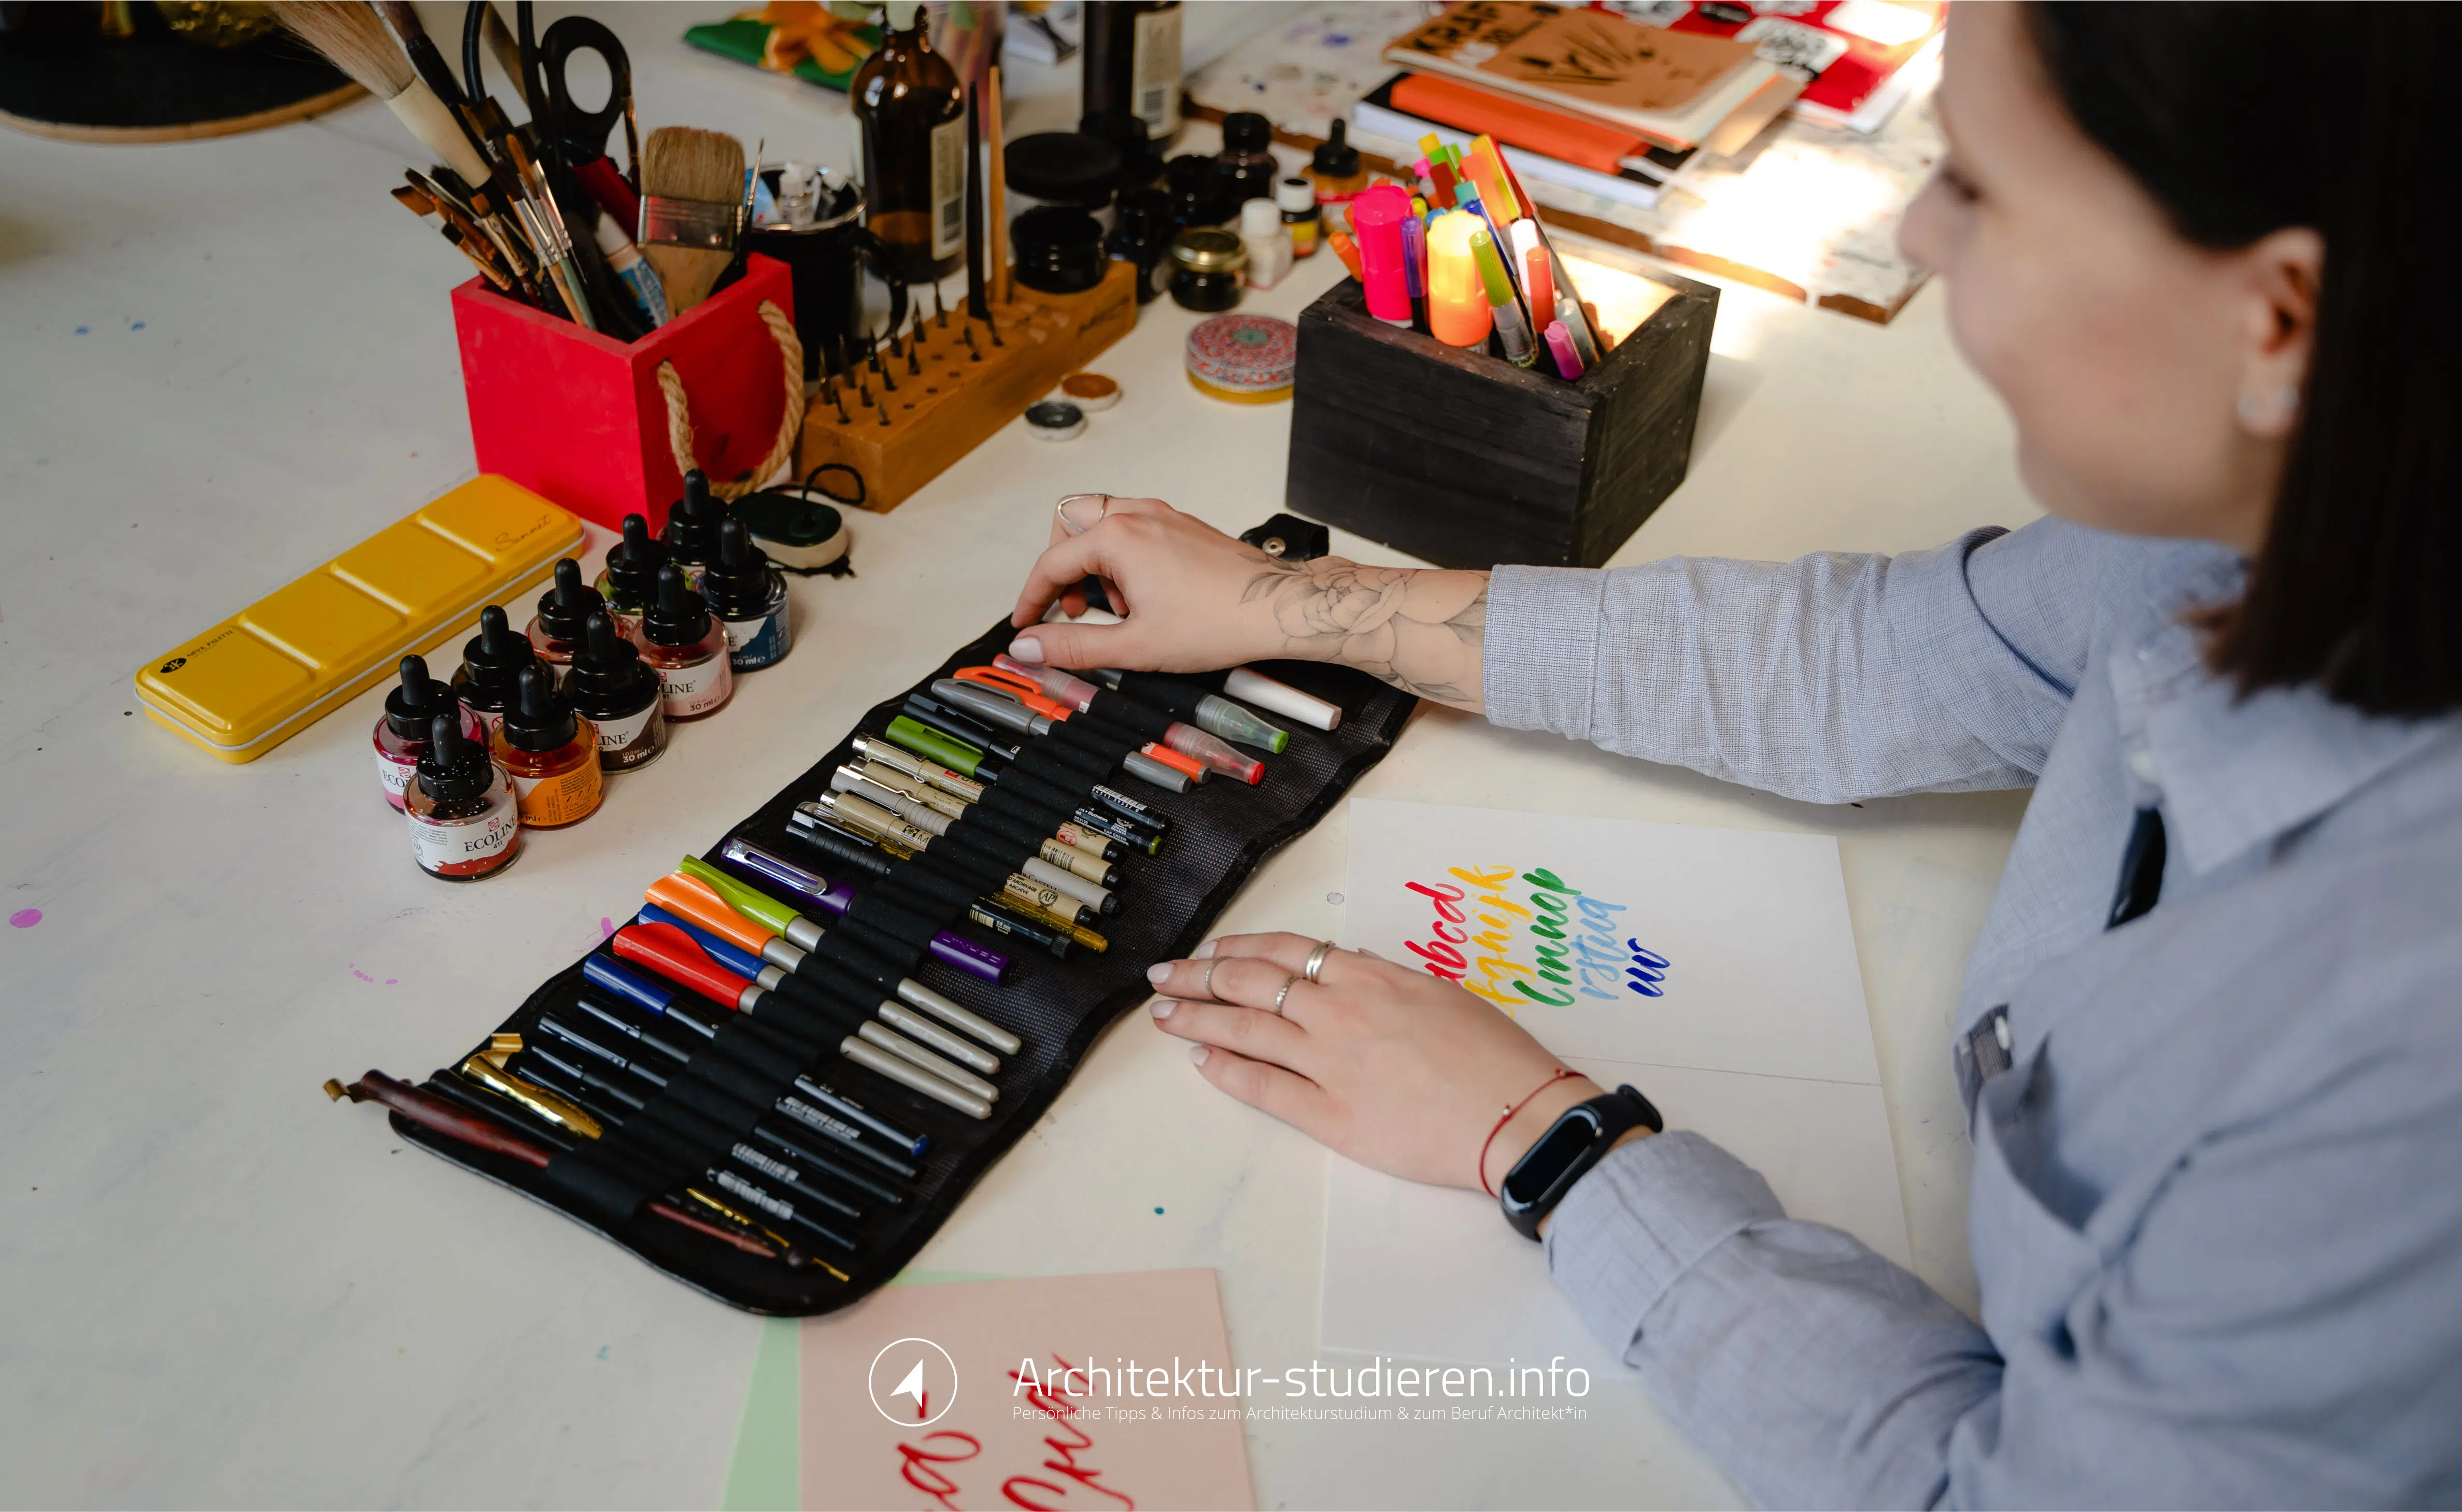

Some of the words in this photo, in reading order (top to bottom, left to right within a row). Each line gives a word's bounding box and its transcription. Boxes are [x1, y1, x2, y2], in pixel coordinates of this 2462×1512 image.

[623, 755, 635, 763] 30
[382, 769, 408, 788] ECO
[463, 814, 516, 852] ECOLINE
